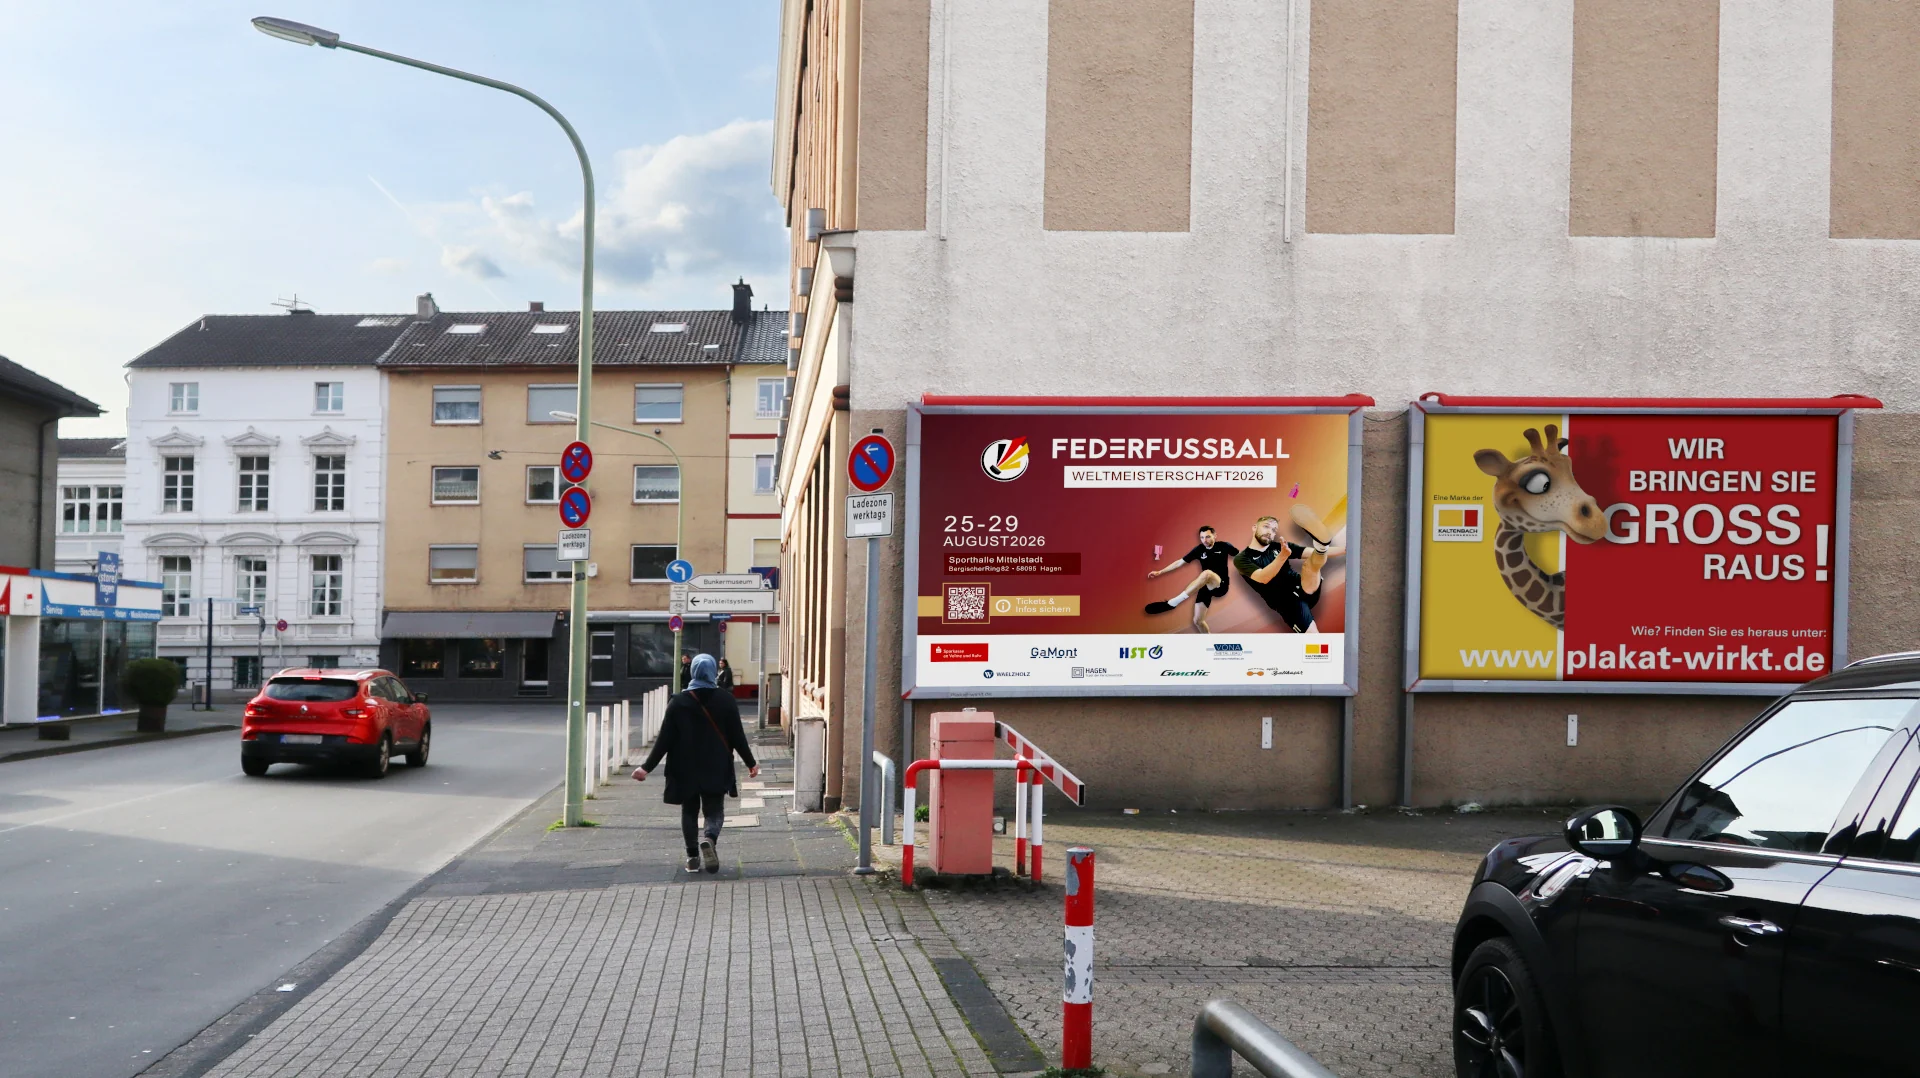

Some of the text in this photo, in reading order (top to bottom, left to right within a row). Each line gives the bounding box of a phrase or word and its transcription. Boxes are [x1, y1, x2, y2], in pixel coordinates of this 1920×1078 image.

[1052, 438, 1290, 459] FEDERFUSSBALL
[1668, 438, 1725, 459] WIR
[1072, 470, 1264, 482] WELTMEISTERSCHAFT2026
[1629, 470, 1816, 492] BRINGEN SIE
[852, 498, 888, 509] Ladezone
[852, 511, 886, 520] werktags
[944, 515, 1019, 532] 25-29
[1602, 502, 1801, 545] GROSS
[562, 532, 587, 540] Ladezone
[563, 541, 586, 549] werktags
[948, 556, 1044, 564] Sporthalle Mittelstadt
[1703, 553, 1805, 581] RAUS
[703, 598, 754, 606] Parkleitsystem
[1015, 597, 1055, 605] Tickets &
[46, 606, 63, 615] Service
[1631, 625, 1827, 638] Wie? Finden Sie es heraus unter:
[1030, 647, 1078, 658] GaMont
[1119, 647, 1147, 659] HST
[1459, 643, 1825, 675] www plakat-wirkt.de
[1160, 669, 1211, 677] Gmatic
